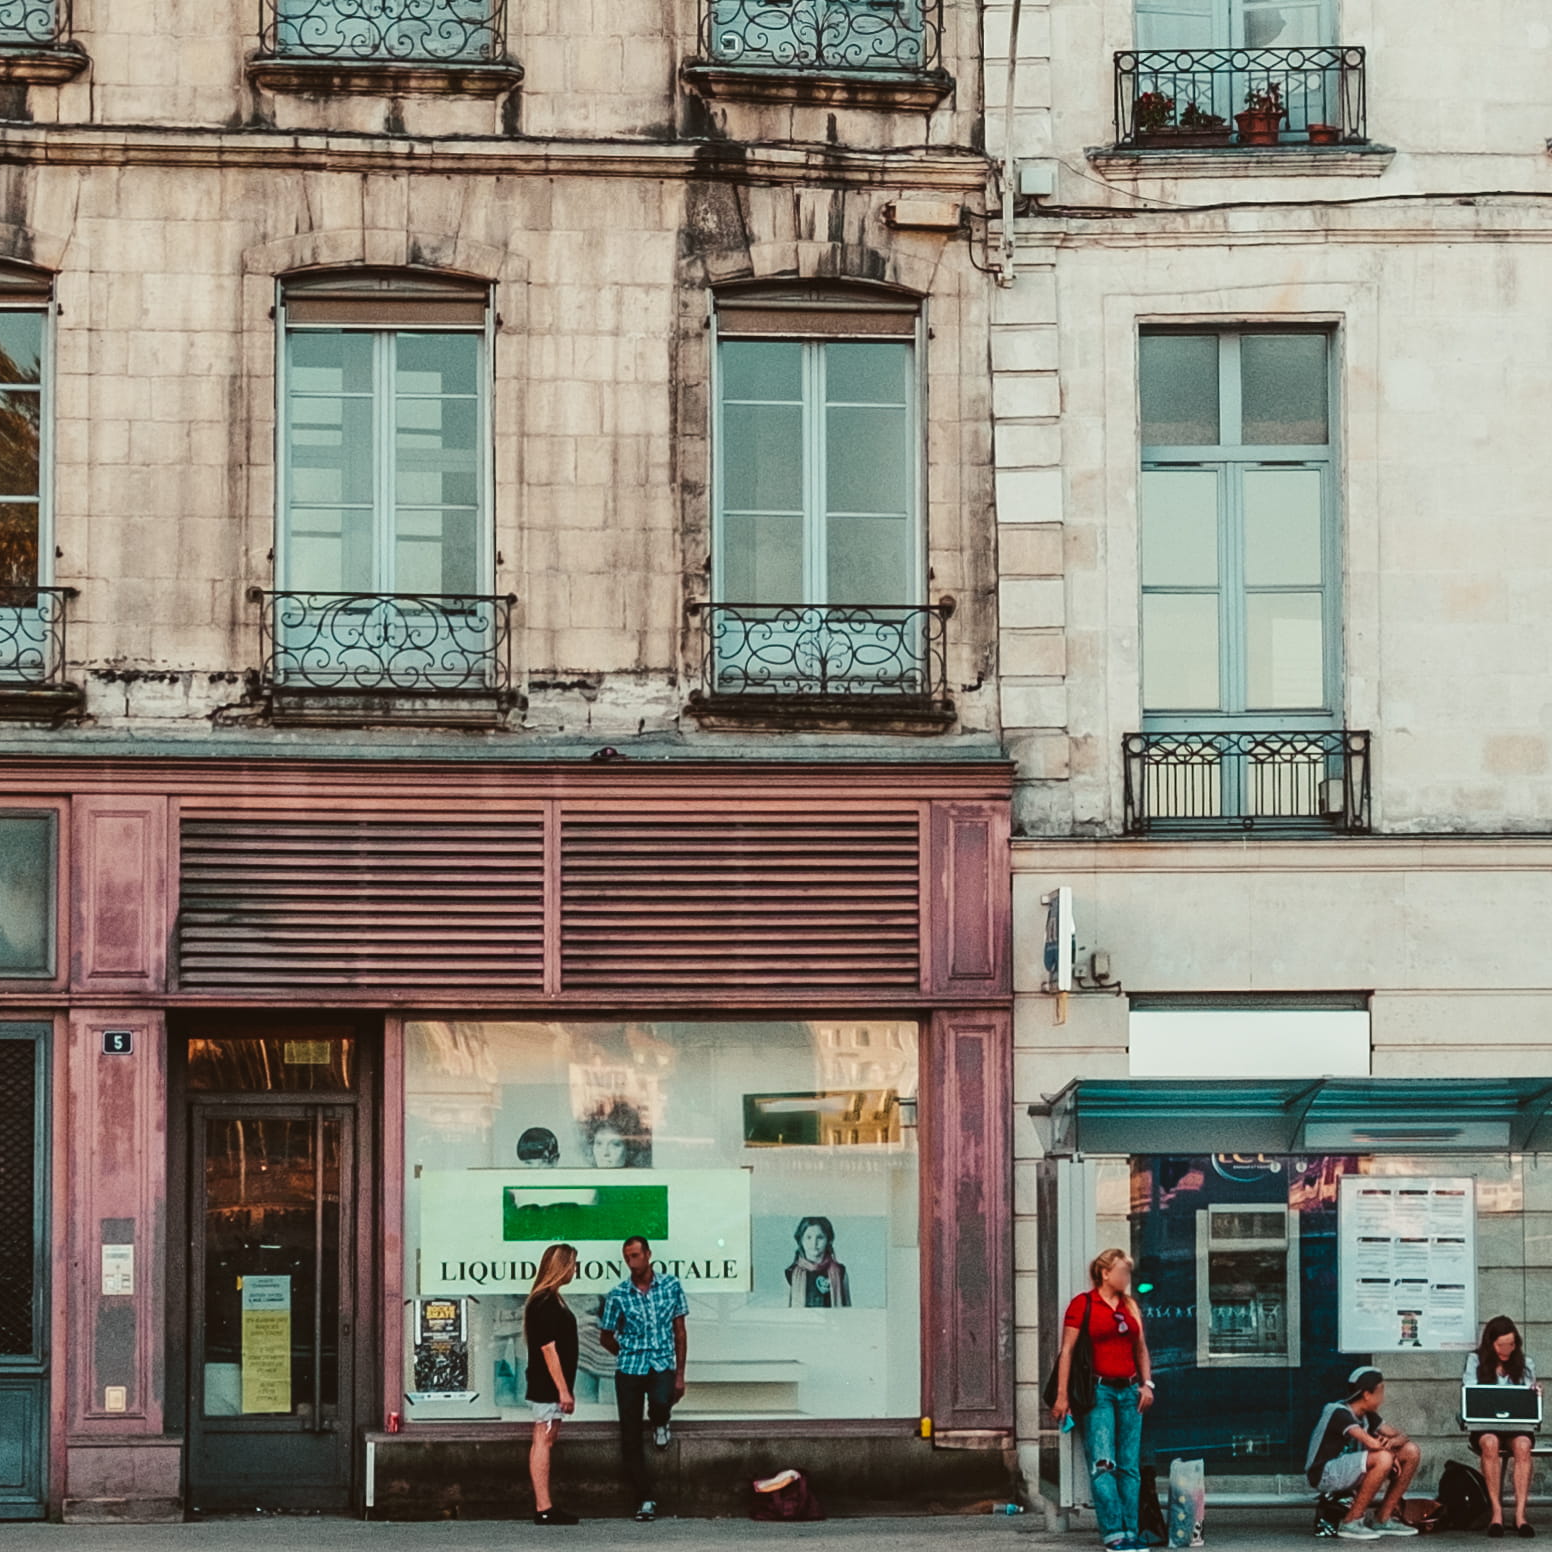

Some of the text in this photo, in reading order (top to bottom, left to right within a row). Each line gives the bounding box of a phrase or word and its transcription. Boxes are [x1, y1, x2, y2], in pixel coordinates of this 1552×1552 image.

[114, 1035, 123, 1049] 5
[441, 1259, 738, 1285] LIQUIDION OTALE
